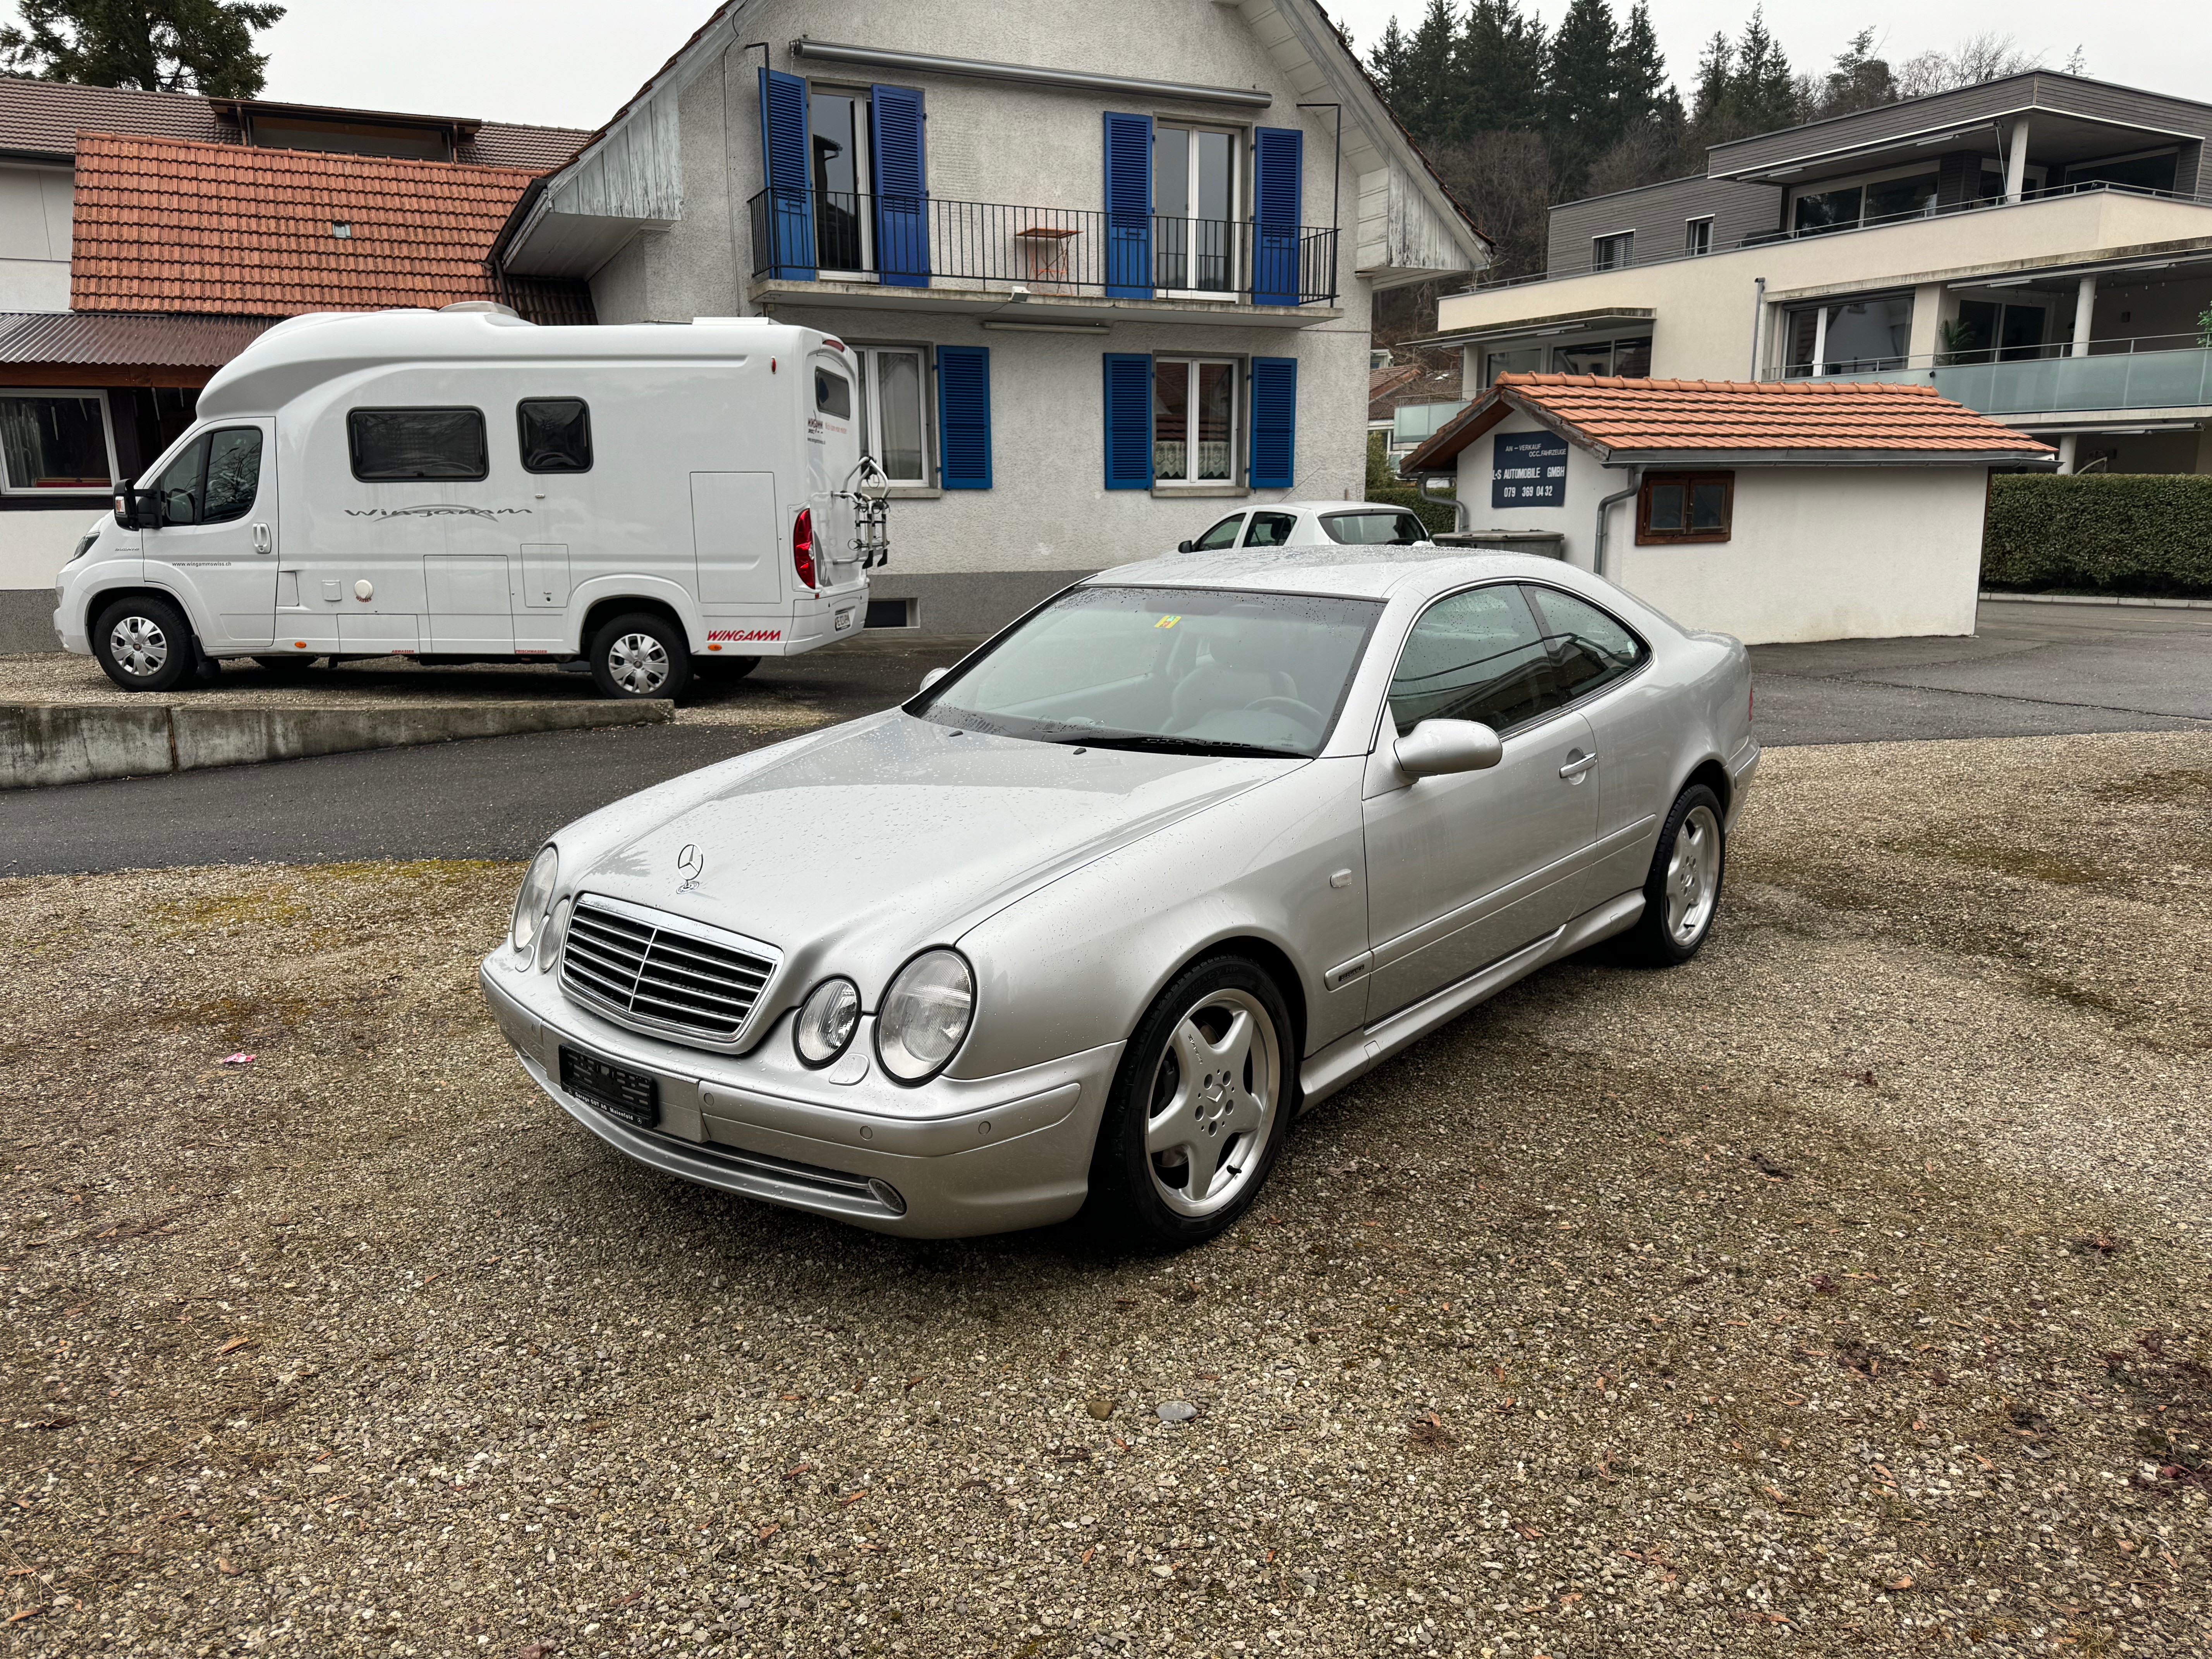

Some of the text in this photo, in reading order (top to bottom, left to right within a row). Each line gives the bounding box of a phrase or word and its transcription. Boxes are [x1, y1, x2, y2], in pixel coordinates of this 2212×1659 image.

[1503, 467, 1541, 479] AUTOMOBILE
[1547, 466, 1565, 477] GMBH
[1504, 486, 1553, 498] 079 369 04 32
[707, 630, 781, 641] WINGAMM
[575, 1092, 589, 1103] Garage
[591, 1097, 599, 1107] GUT
